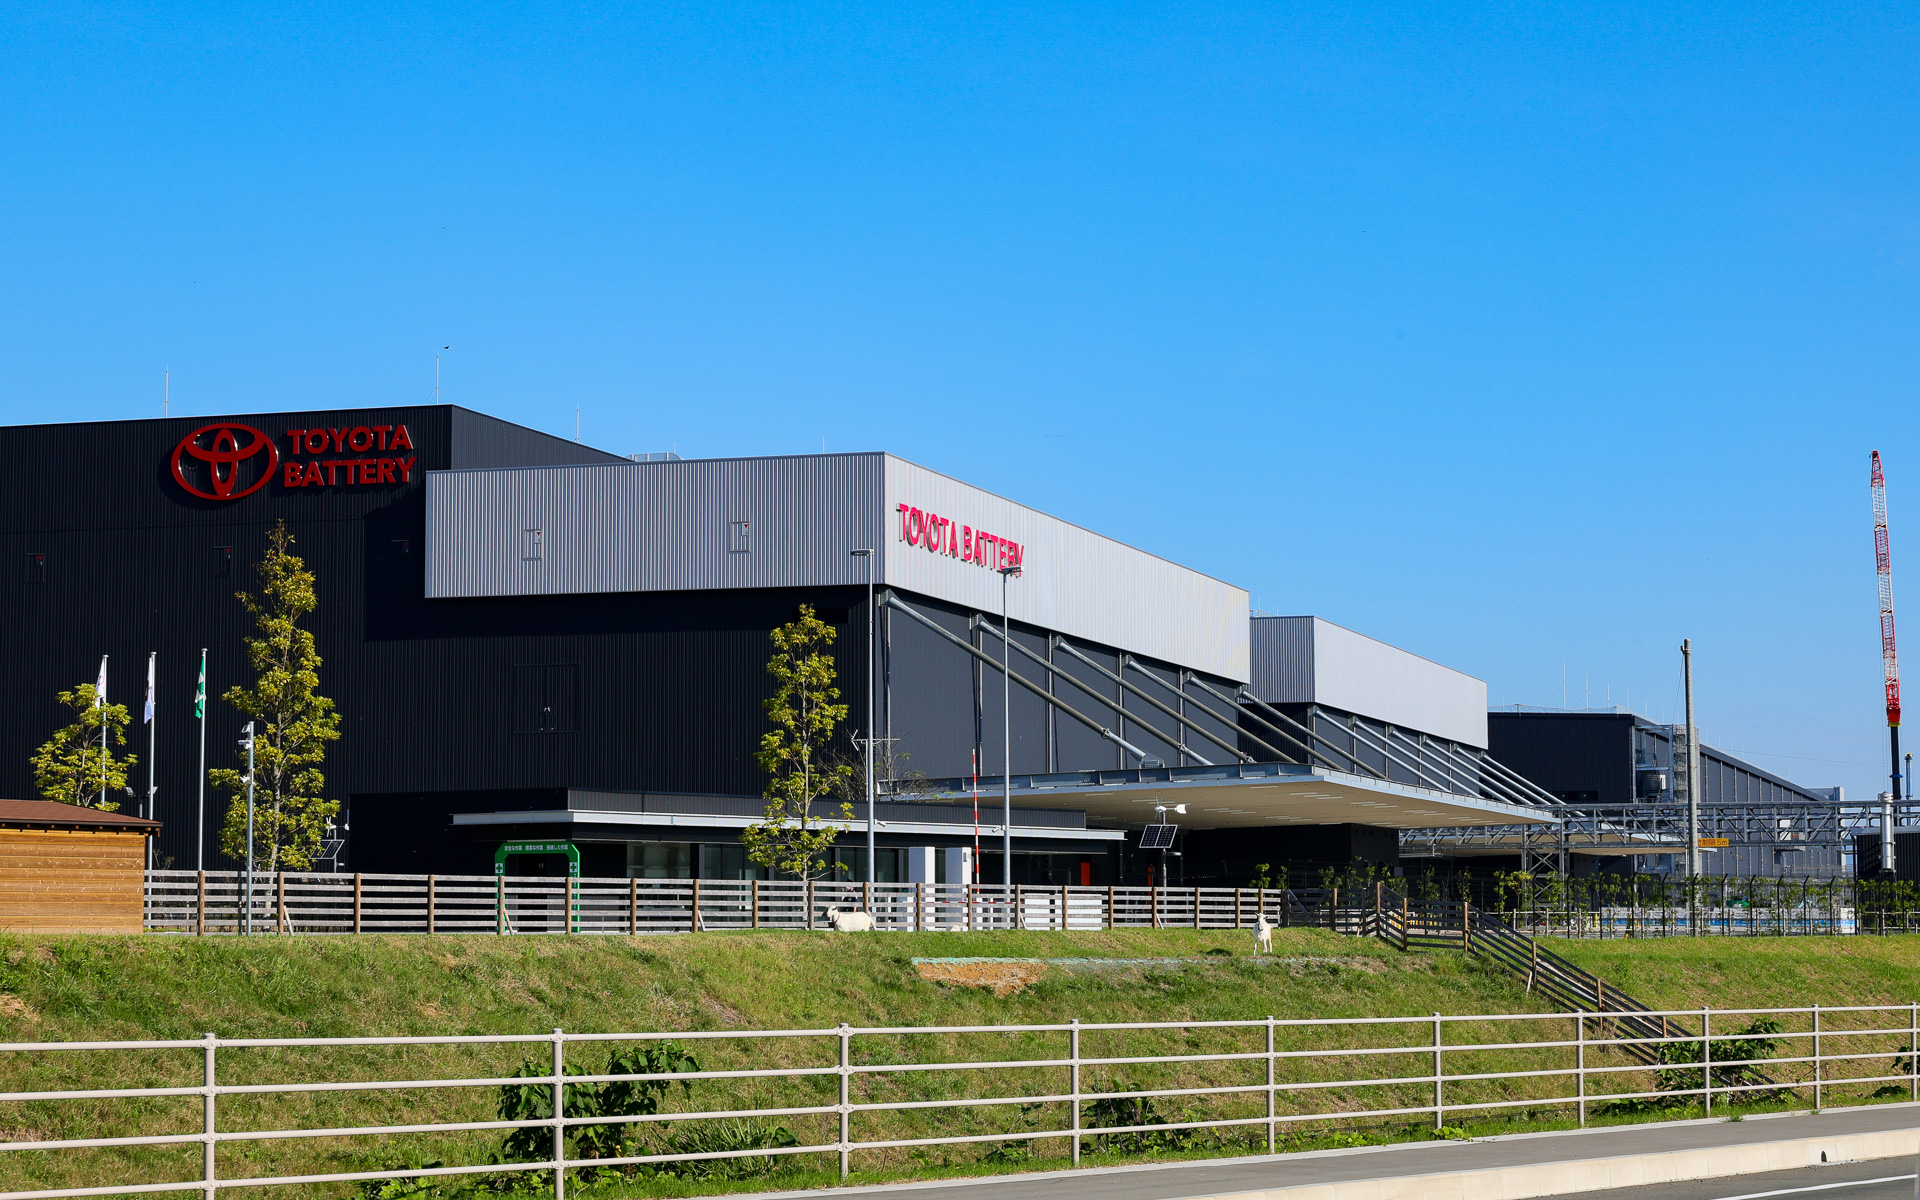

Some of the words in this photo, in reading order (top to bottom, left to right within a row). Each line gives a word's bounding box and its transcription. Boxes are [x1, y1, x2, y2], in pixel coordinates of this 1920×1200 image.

[287, 424, 414, 455] TOYOTA
[284, 456, 417, 488] BATTERY
[897, 502, 959, 558] TOYOTA
[961, 525, 1024, 578] BATTERY
